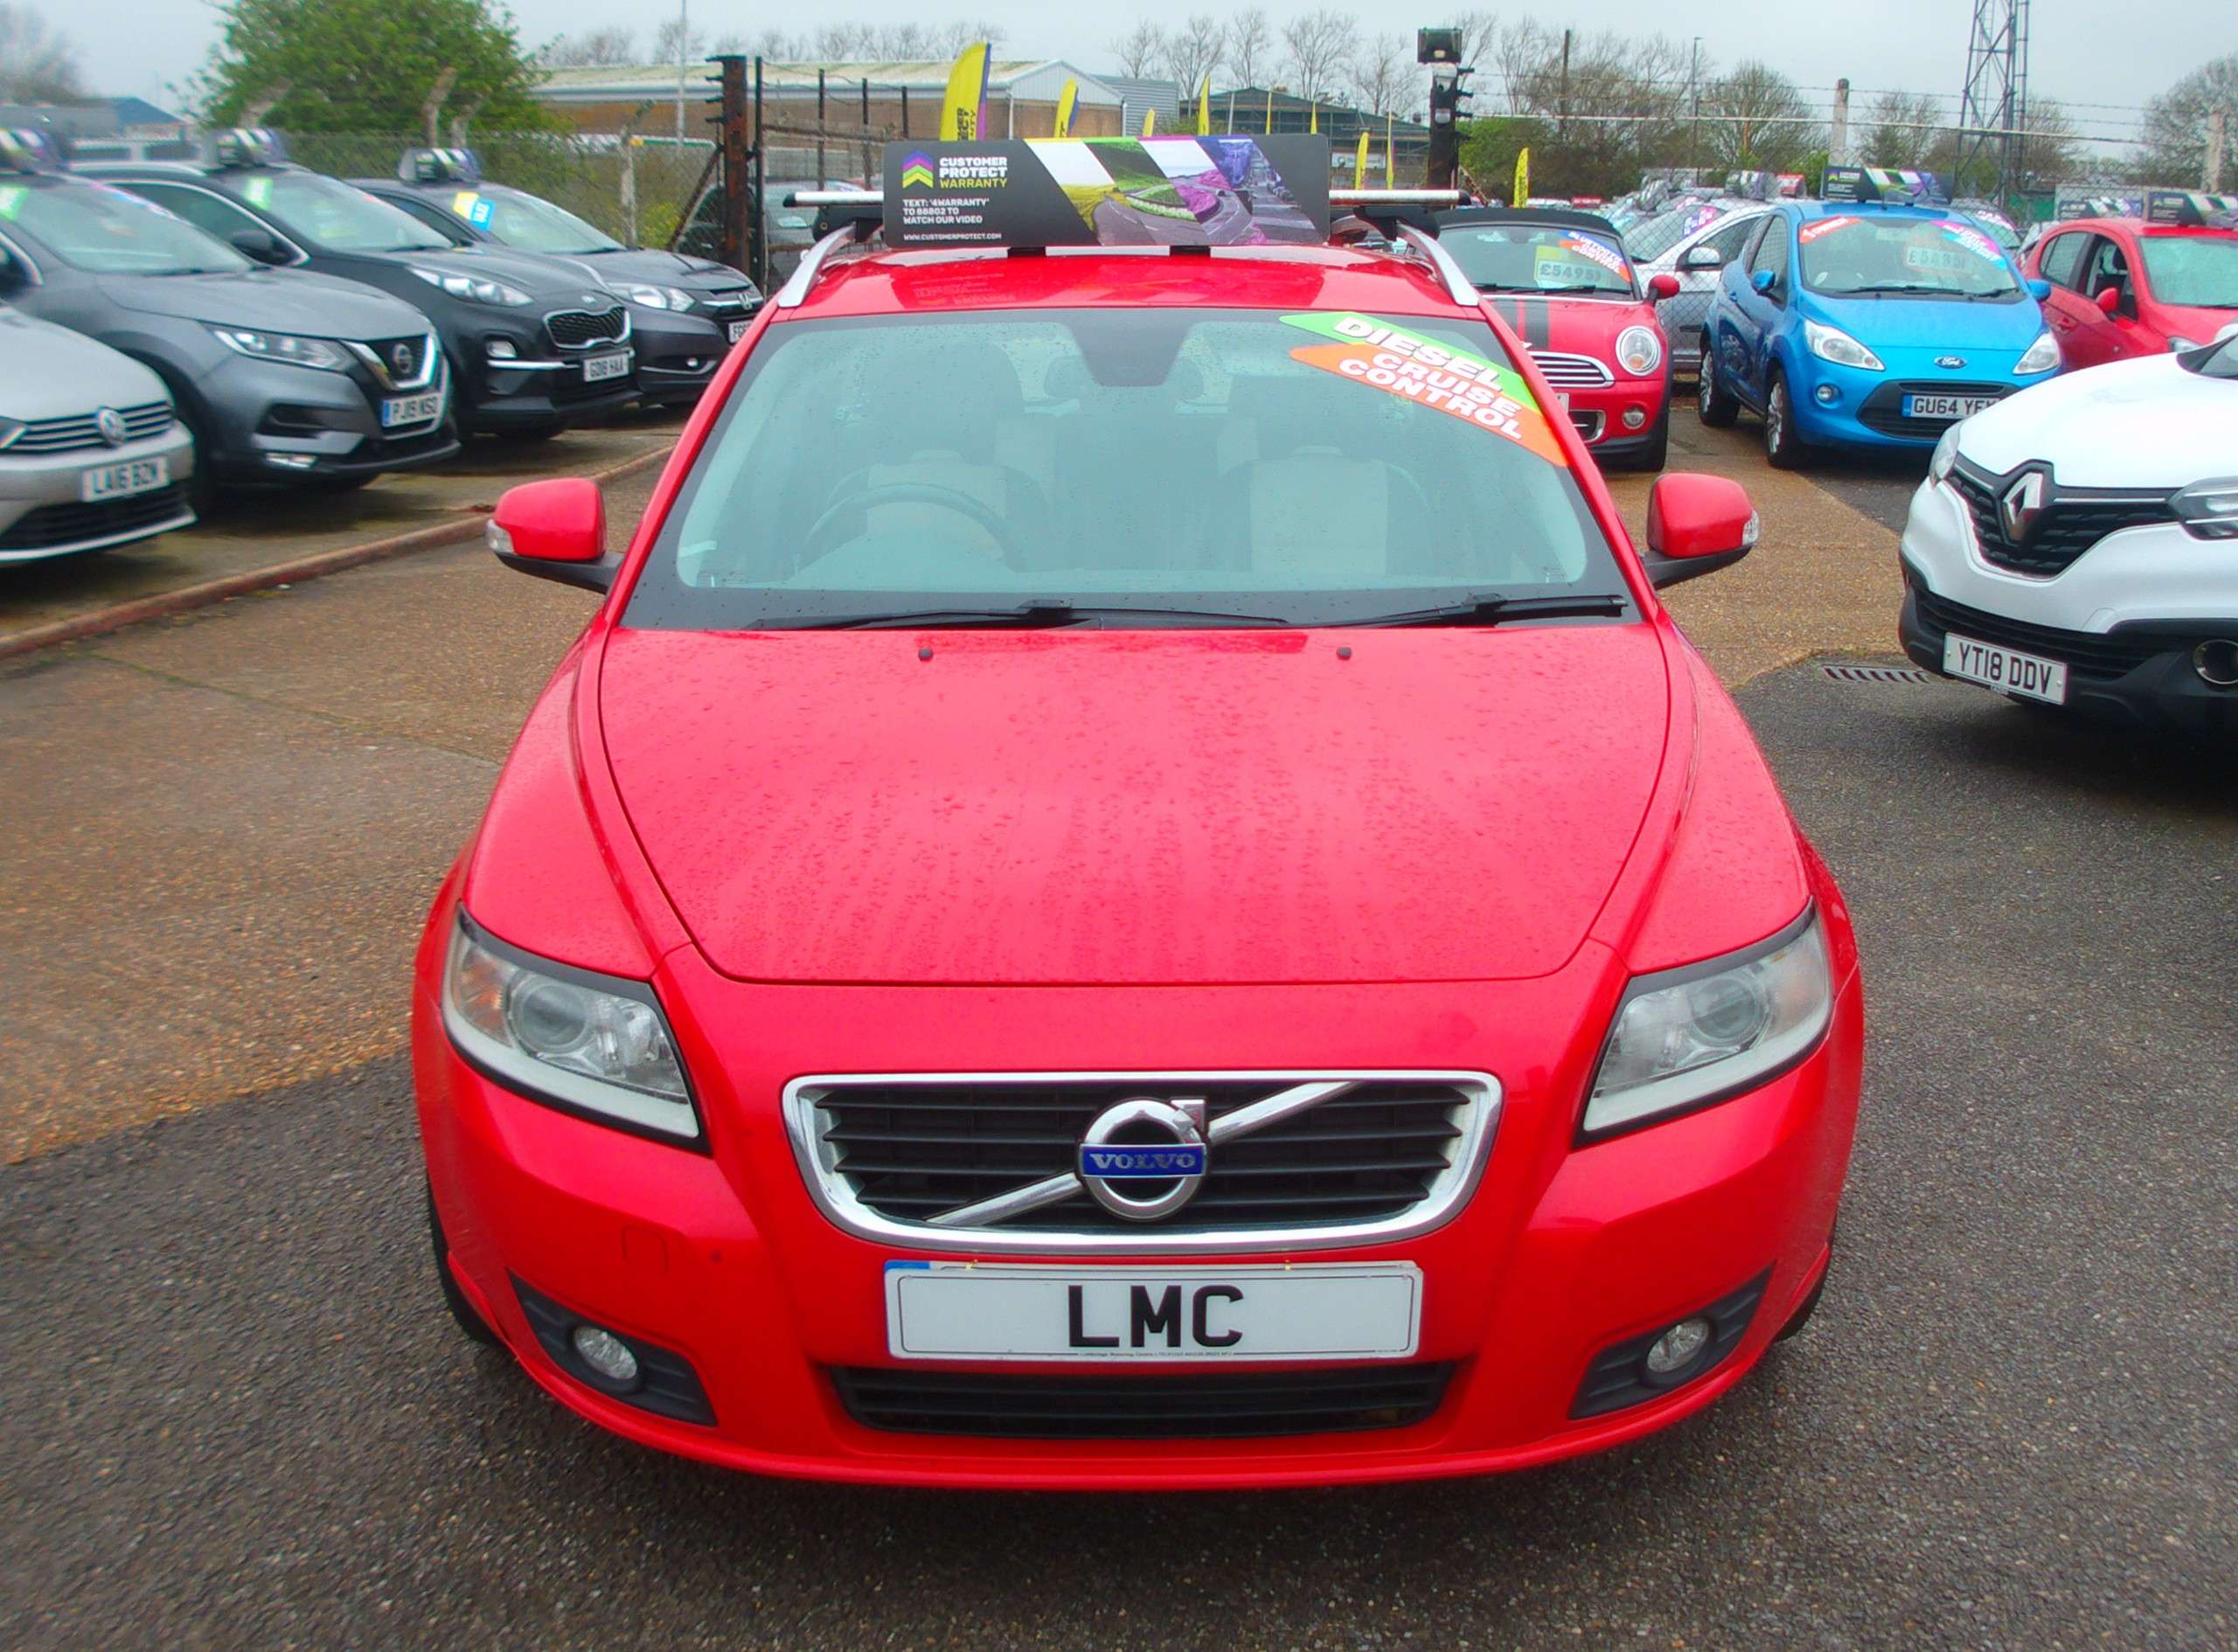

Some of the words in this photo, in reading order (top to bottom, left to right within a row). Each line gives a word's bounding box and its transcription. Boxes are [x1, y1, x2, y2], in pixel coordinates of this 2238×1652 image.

[939, 156, 1008, 167] CUSTOMER
[939, 167, 1008, 178] PROTECT
[939, 178, 1008, 189] WARRANTY
[903, 216, 935, 225] WATCH
[956, 215, 983, 224] VIDEO
[903, 233, 1003, 241] WWW.CUSTOMERPROTECT.COM
[1332, 316, 1503, 392] DIESEL
[1372, 352, 1522, 418] CRUISE
[1339, 358, 1523, 440] CONTROL
[1914, 398, 1958, 414] GU64
[1959, 642, 2003, 682] YT18
[2008, 656, 2053, 695] DDV
[1088, 1153, 1196, 1170] VOLVO
[1067, 1284, 1245, 1349] LMC
